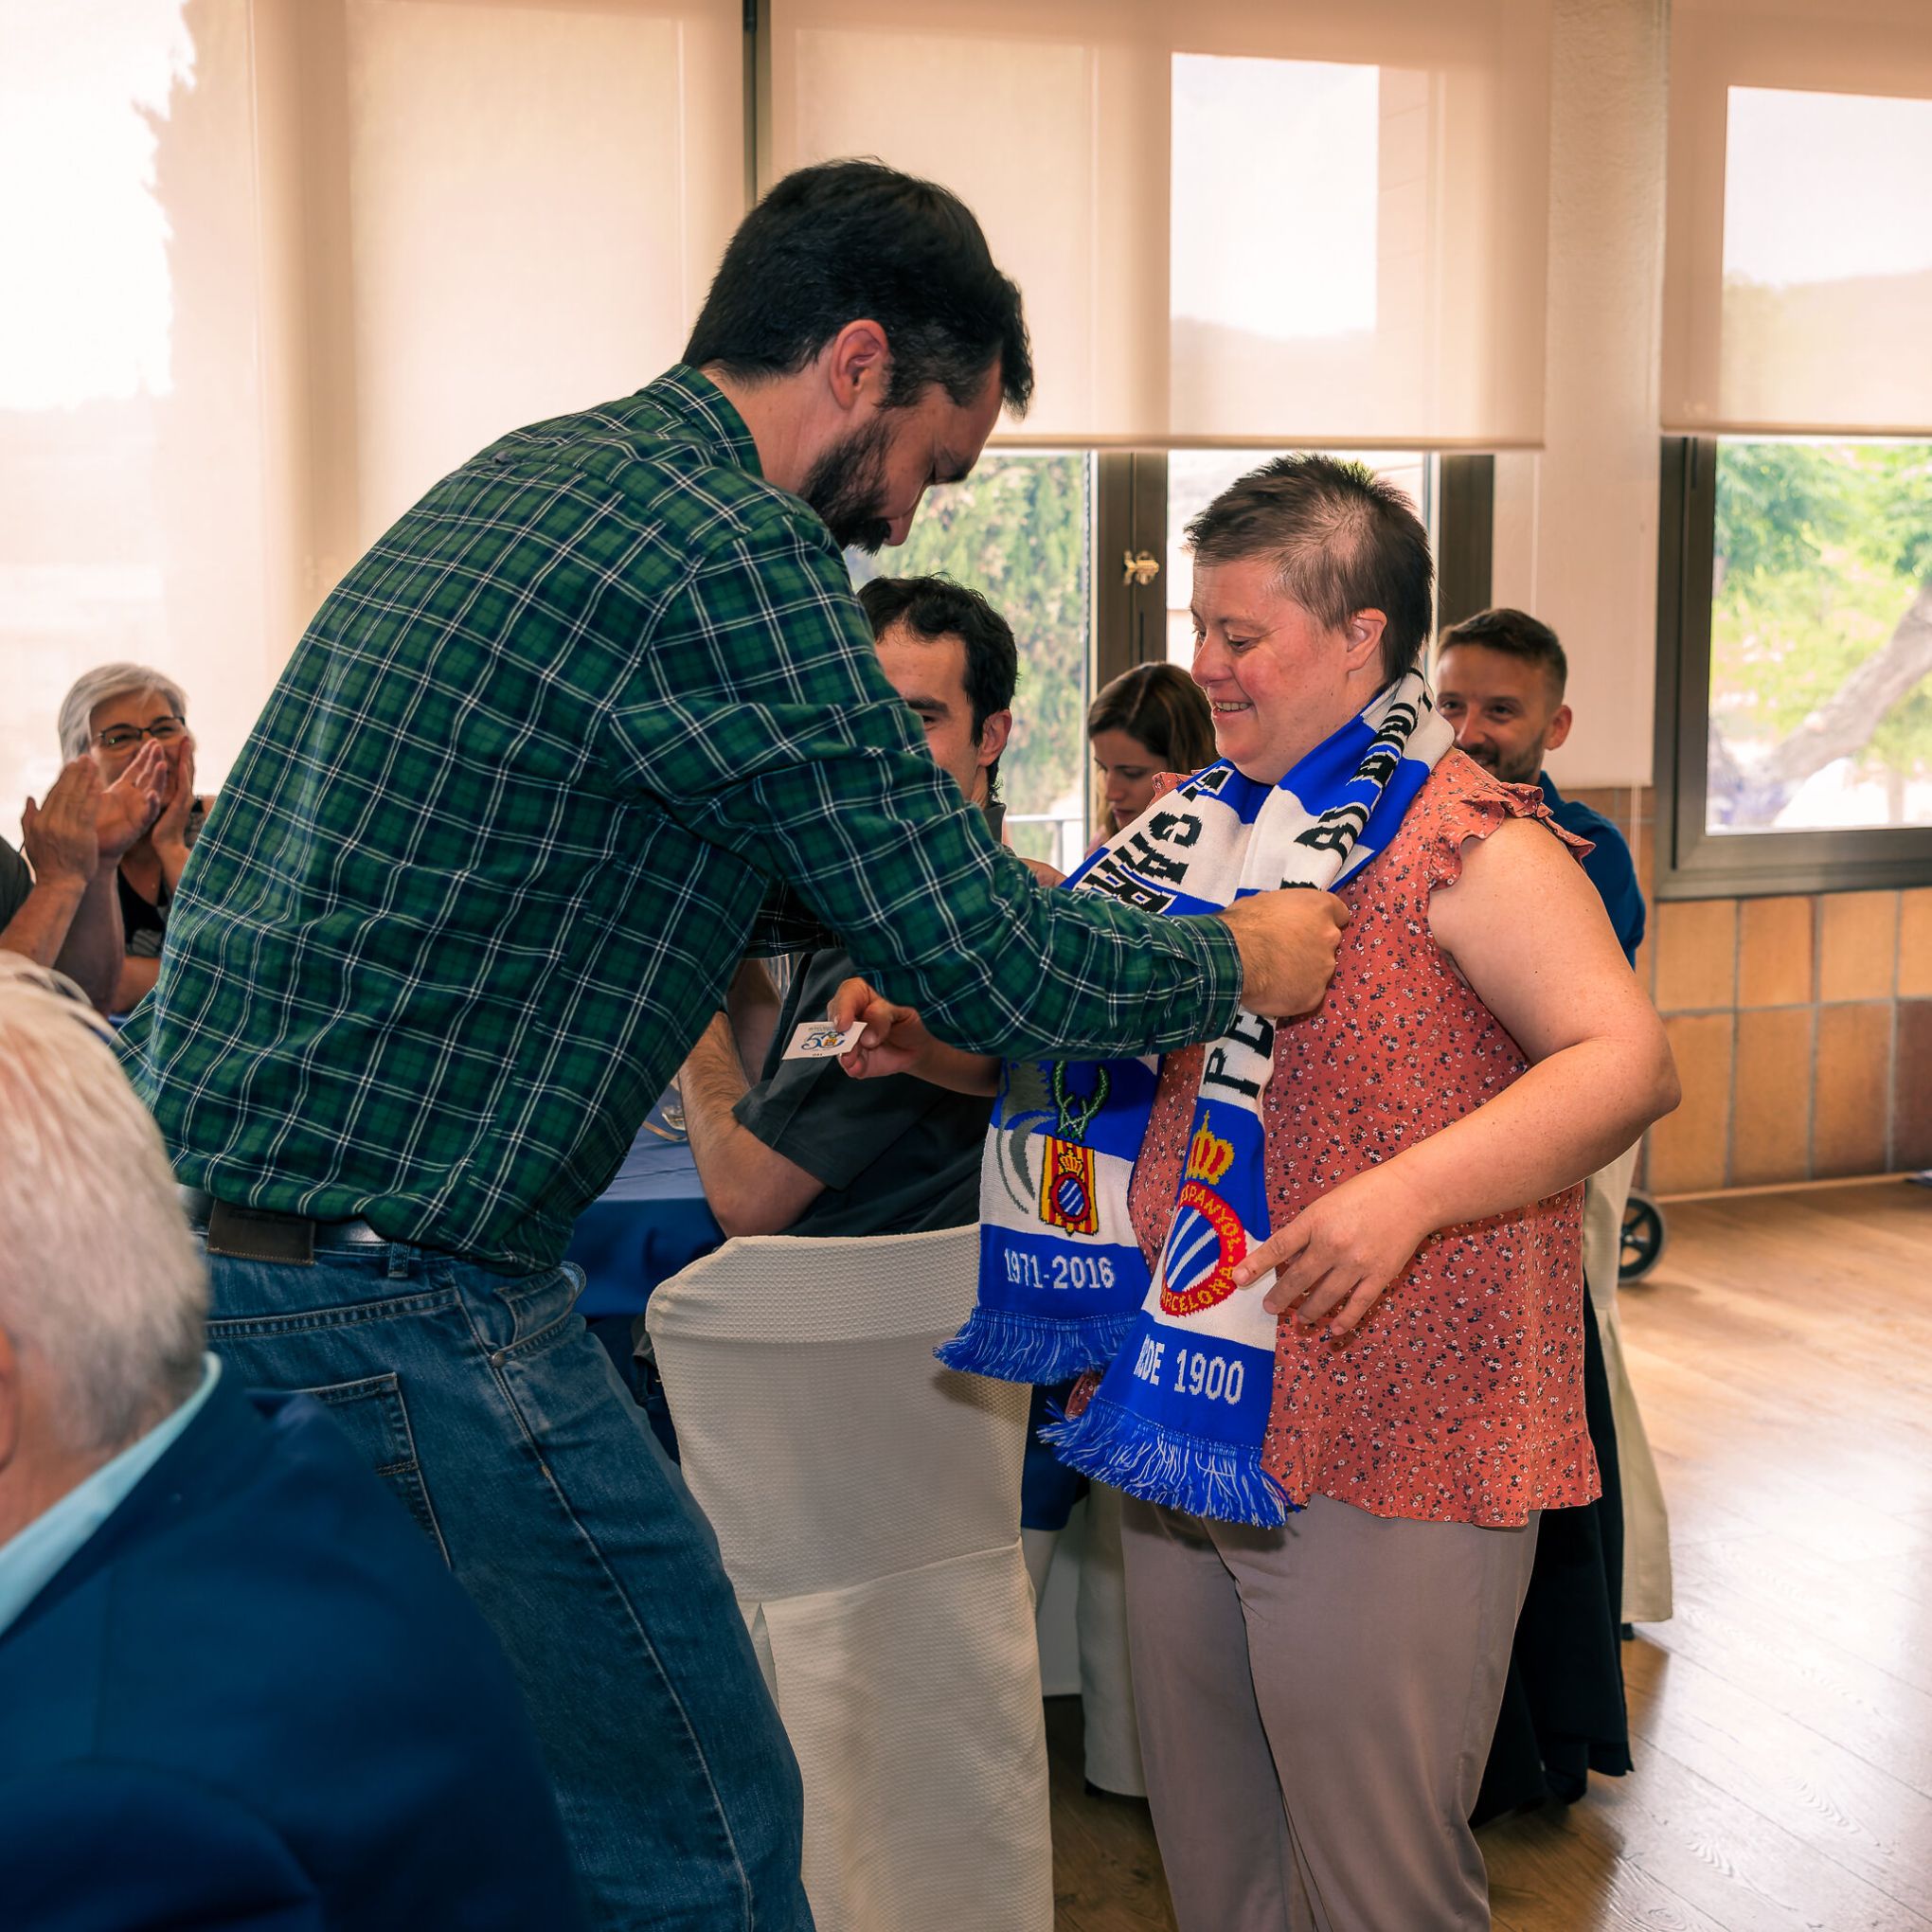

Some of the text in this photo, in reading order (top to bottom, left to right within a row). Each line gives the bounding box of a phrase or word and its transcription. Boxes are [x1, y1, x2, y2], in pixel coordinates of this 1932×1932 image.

[1076, 810, 1203, 912] GAR
[1004, 1247, 1115, 1289] 1971-2016
[1173, 1349, 1244, 1405] 1900
